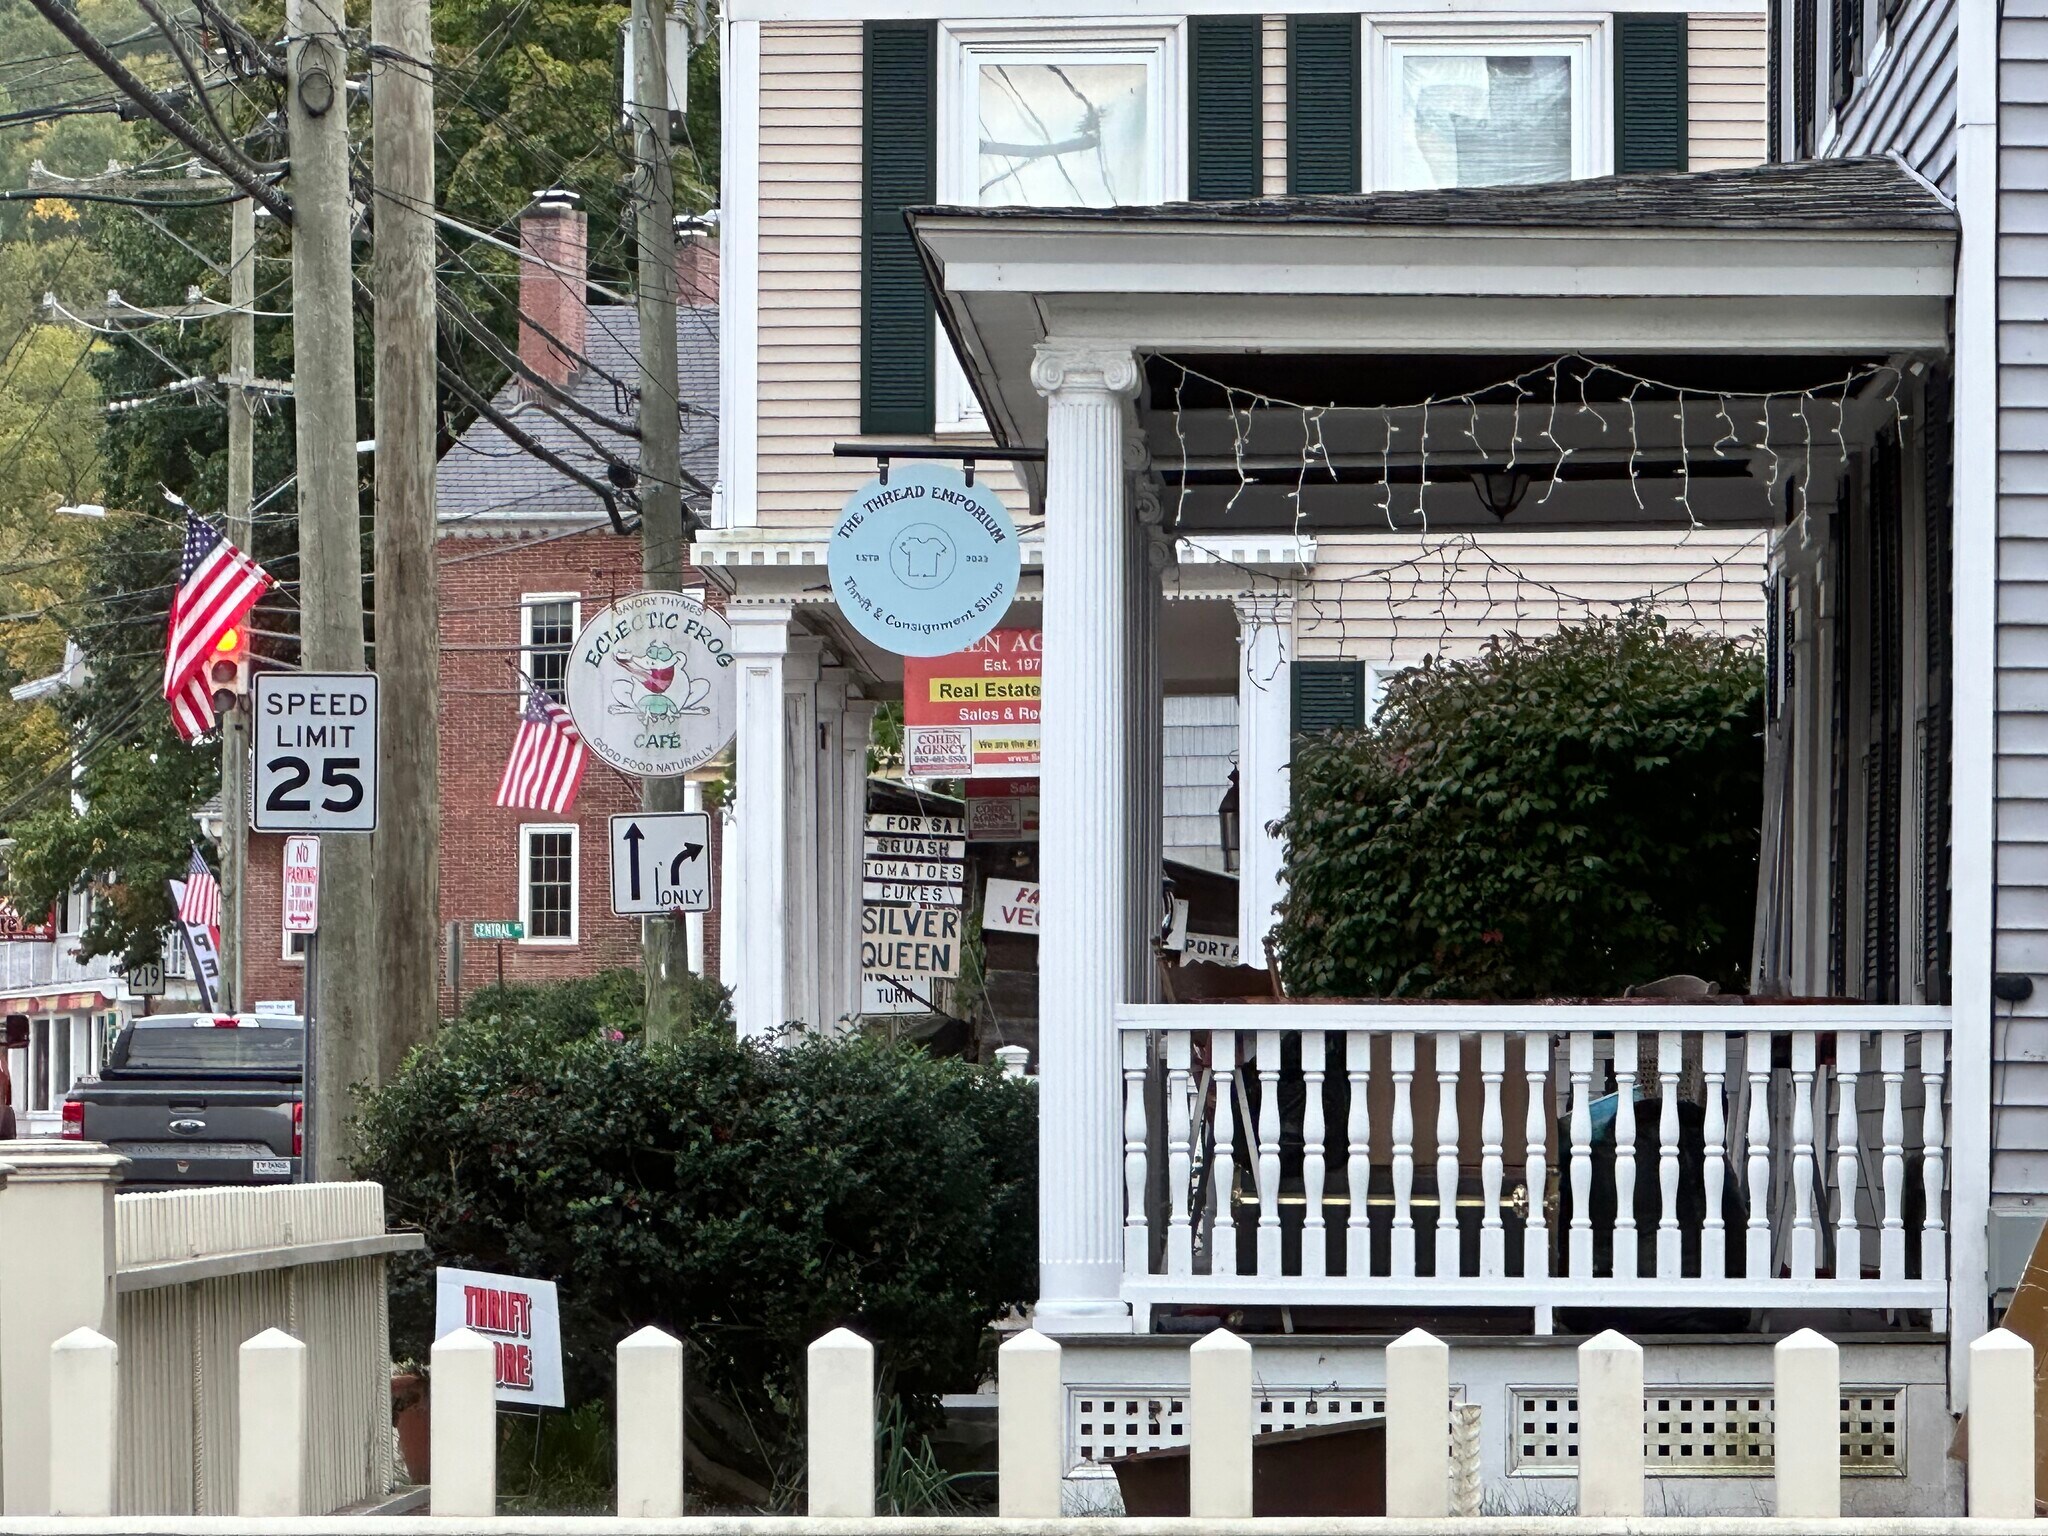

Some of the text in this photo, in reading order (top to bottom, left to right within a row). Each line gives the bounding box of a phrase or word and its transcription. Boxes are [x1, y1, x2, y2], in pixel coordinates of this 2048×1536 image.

[838, 485, 1006, 544] THE THREAD EMPORIUM
[615, 596, 705, 617] SAVORY THYMES
[844, 577, 1003, 634] Thrift & Consignment Shop
[585, 612, 736, 668] ECLECTIC FROG
[984, 659, 1011, 672] Est.
[940, 682, 1040, 698] Real Estate
[266, 693, 367, 715] SPEED
[959, 707, 1041, 721] Sales & Re
[277, 725, 355, 748] LIMIT
[918, 734, 961, 744] COHEN
[593, 737, 715, 773] GOOD FOOD NATURALLY
[914, 744, 966, 755] AGENCY
[266, 756, 364, 812] 25
[886, 817, 921, 832] FOR
[296, 842, 309, 862] NO
[877, 839, 949, 857] SQUASH
[864, 862, 962, 879] TOMATOES
[661, 889, 703, 905] ONLY
[882, 885, 943, 901] CUKES
[474, 923, 512, 937] CENTRAL
[862, 908, 959, 938] SILVER
[862, 941, 951, 972] QUEEN
[133, 967, 159, 987] 219
[877, 988, 913, 1003] TURN
[464, 1285, 533, 1339] THRIFT
